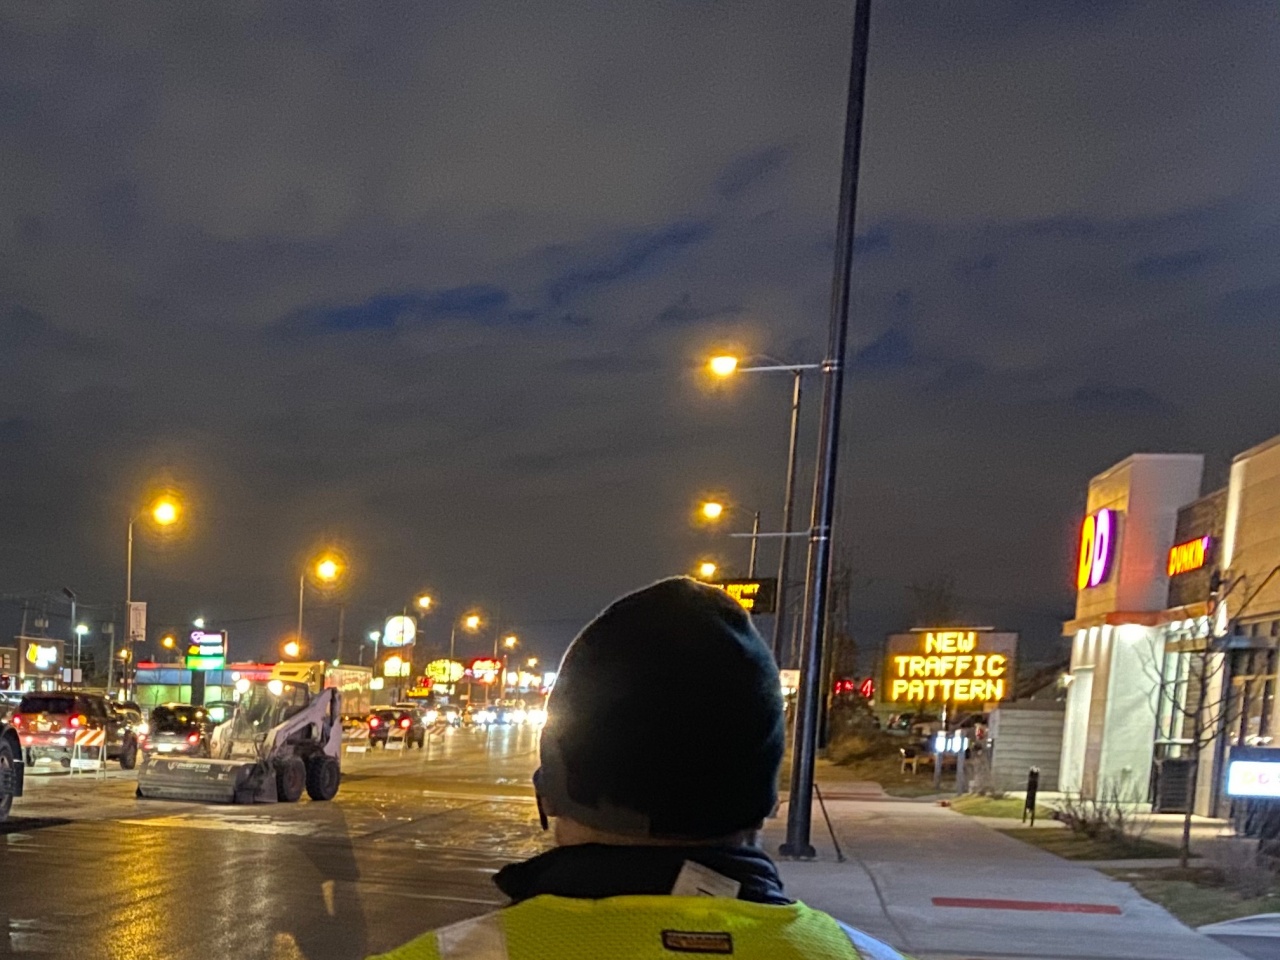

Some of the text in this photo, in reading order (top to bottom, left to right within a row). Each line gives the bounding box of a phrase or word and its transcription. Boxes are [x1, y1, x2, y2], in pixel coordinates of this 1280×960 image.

[925, 631, 975, 654] NEW
[894, 655, 1006, 677] TRAFFIC
[892, 679, 1003, 701] PATTERN
